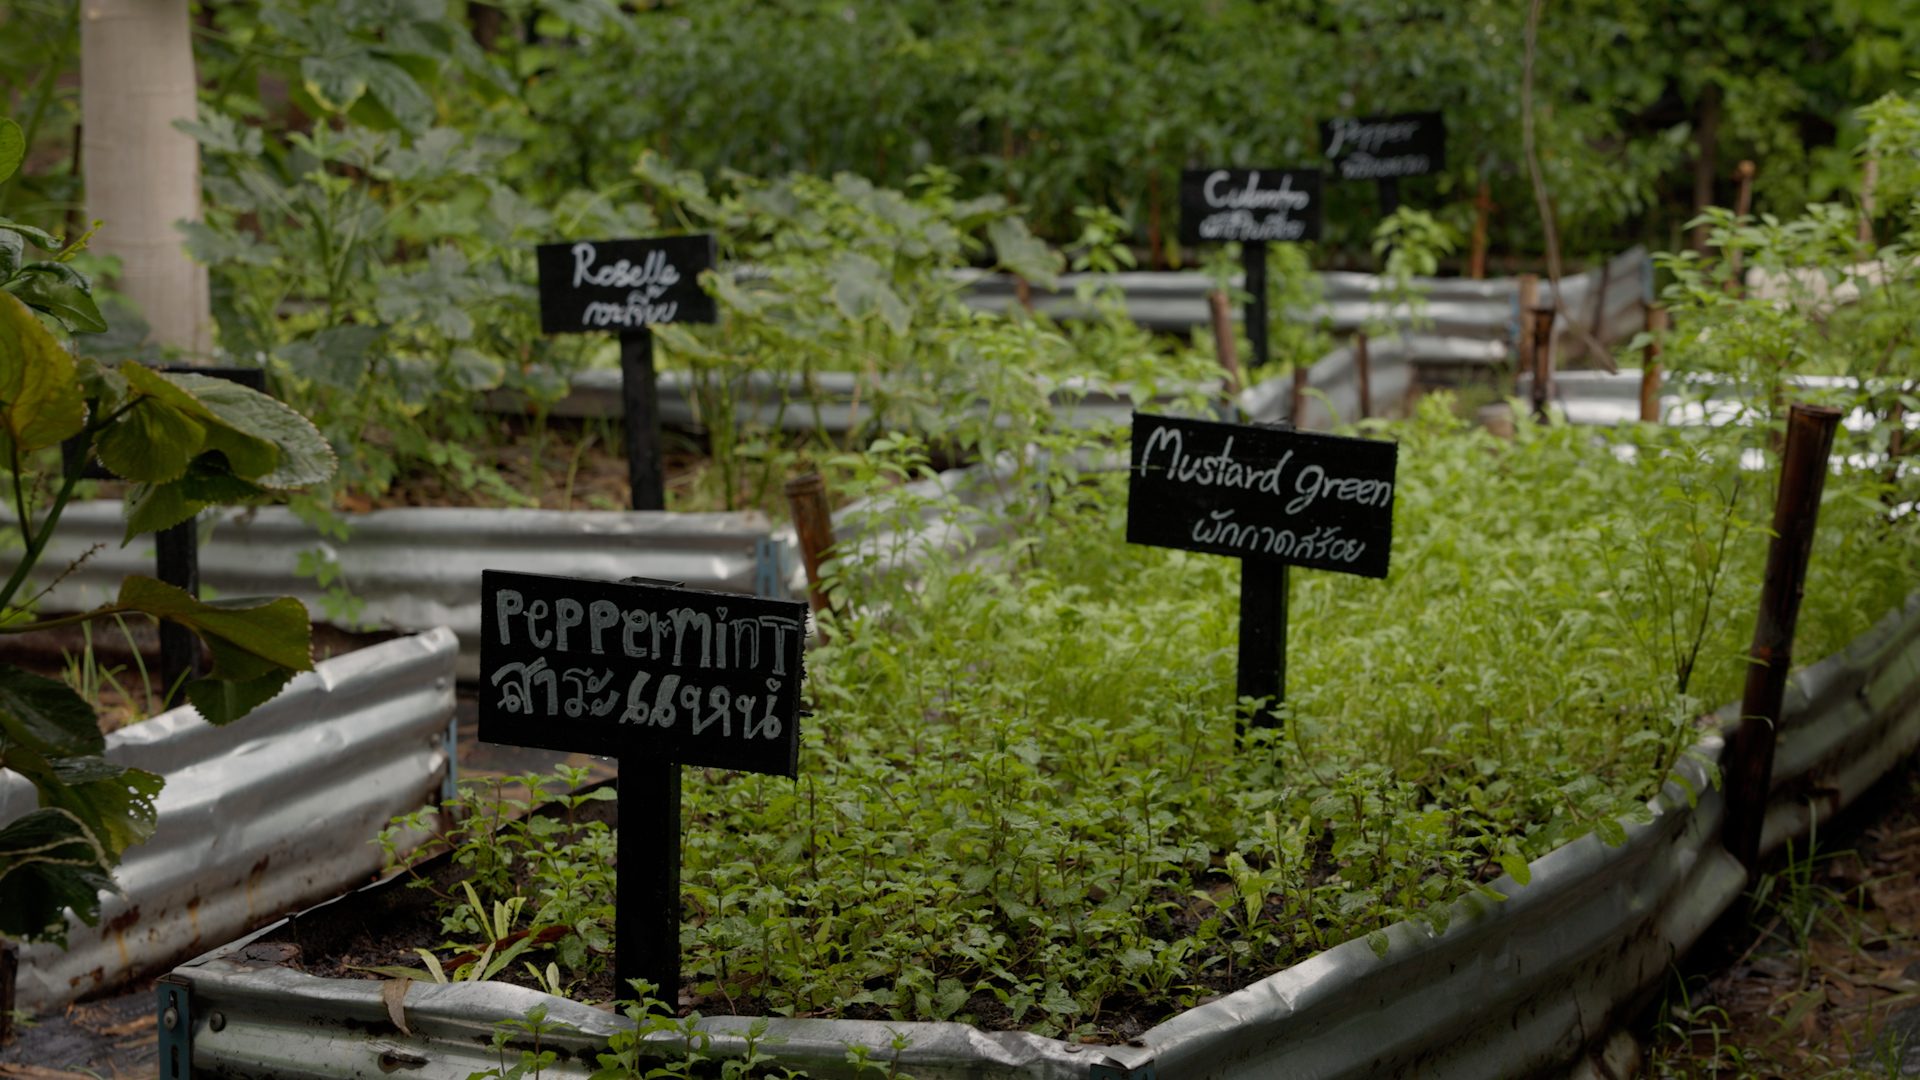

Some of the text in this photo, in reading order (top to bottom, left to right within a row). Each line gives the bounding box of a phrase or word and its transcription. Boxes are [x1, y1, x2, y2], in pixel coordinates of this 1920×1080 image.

[1325, 117, 1421, 159] Pepper
[571, 242, 681, 288] Roselle
[1141, 426, 1294, 495] Mustard
[1192, 509, 1366, 562] ผักกาดสร้อย
[491, 656, 782, 739] สาระแหน่
